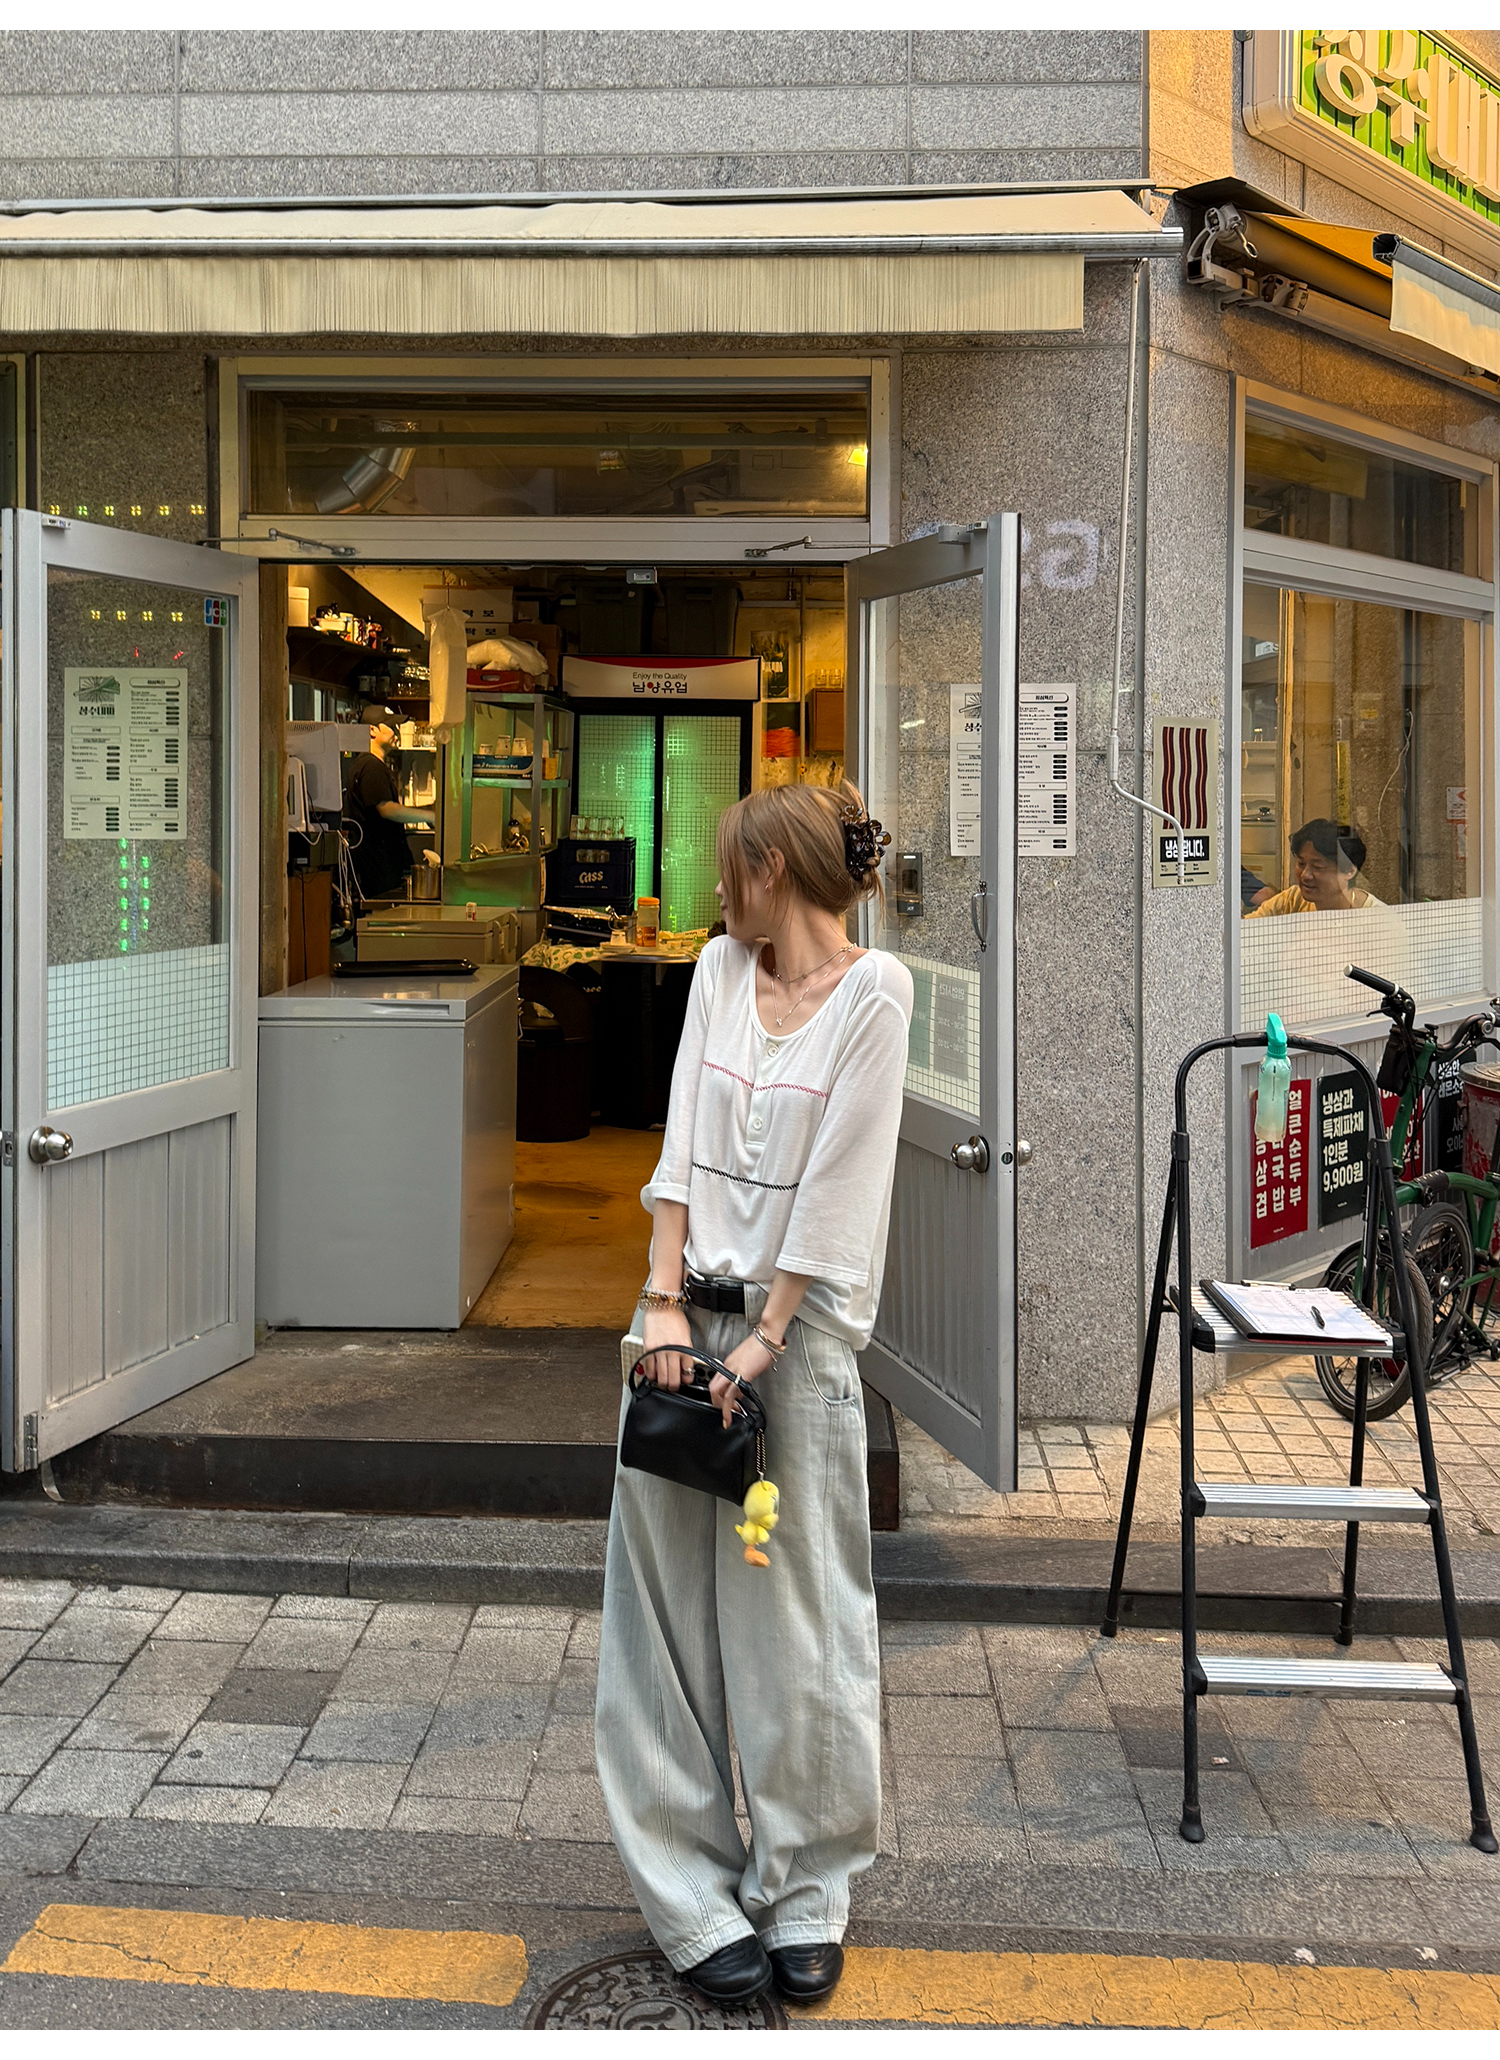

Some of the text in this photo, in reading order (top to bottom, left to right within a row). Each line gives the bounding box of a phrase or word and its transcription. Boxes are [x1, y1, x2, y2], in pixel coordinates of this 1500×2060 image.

[206, 606, 227, 618] JCB
[632, 671, 688, 681] Enjoy the Quality
[632, 681, 688, 694] 남양유업
[1322, 1088, 1354, 1115] 냉삼과
[1322, 1110, 1364, 1140] 특제파채
[1288, 1089, 1302, 1207] 얼큰순두부
[1323, 1140, 1349, 1166] 1인분
[1322, 1160, 1364, 1193] 9,900원
